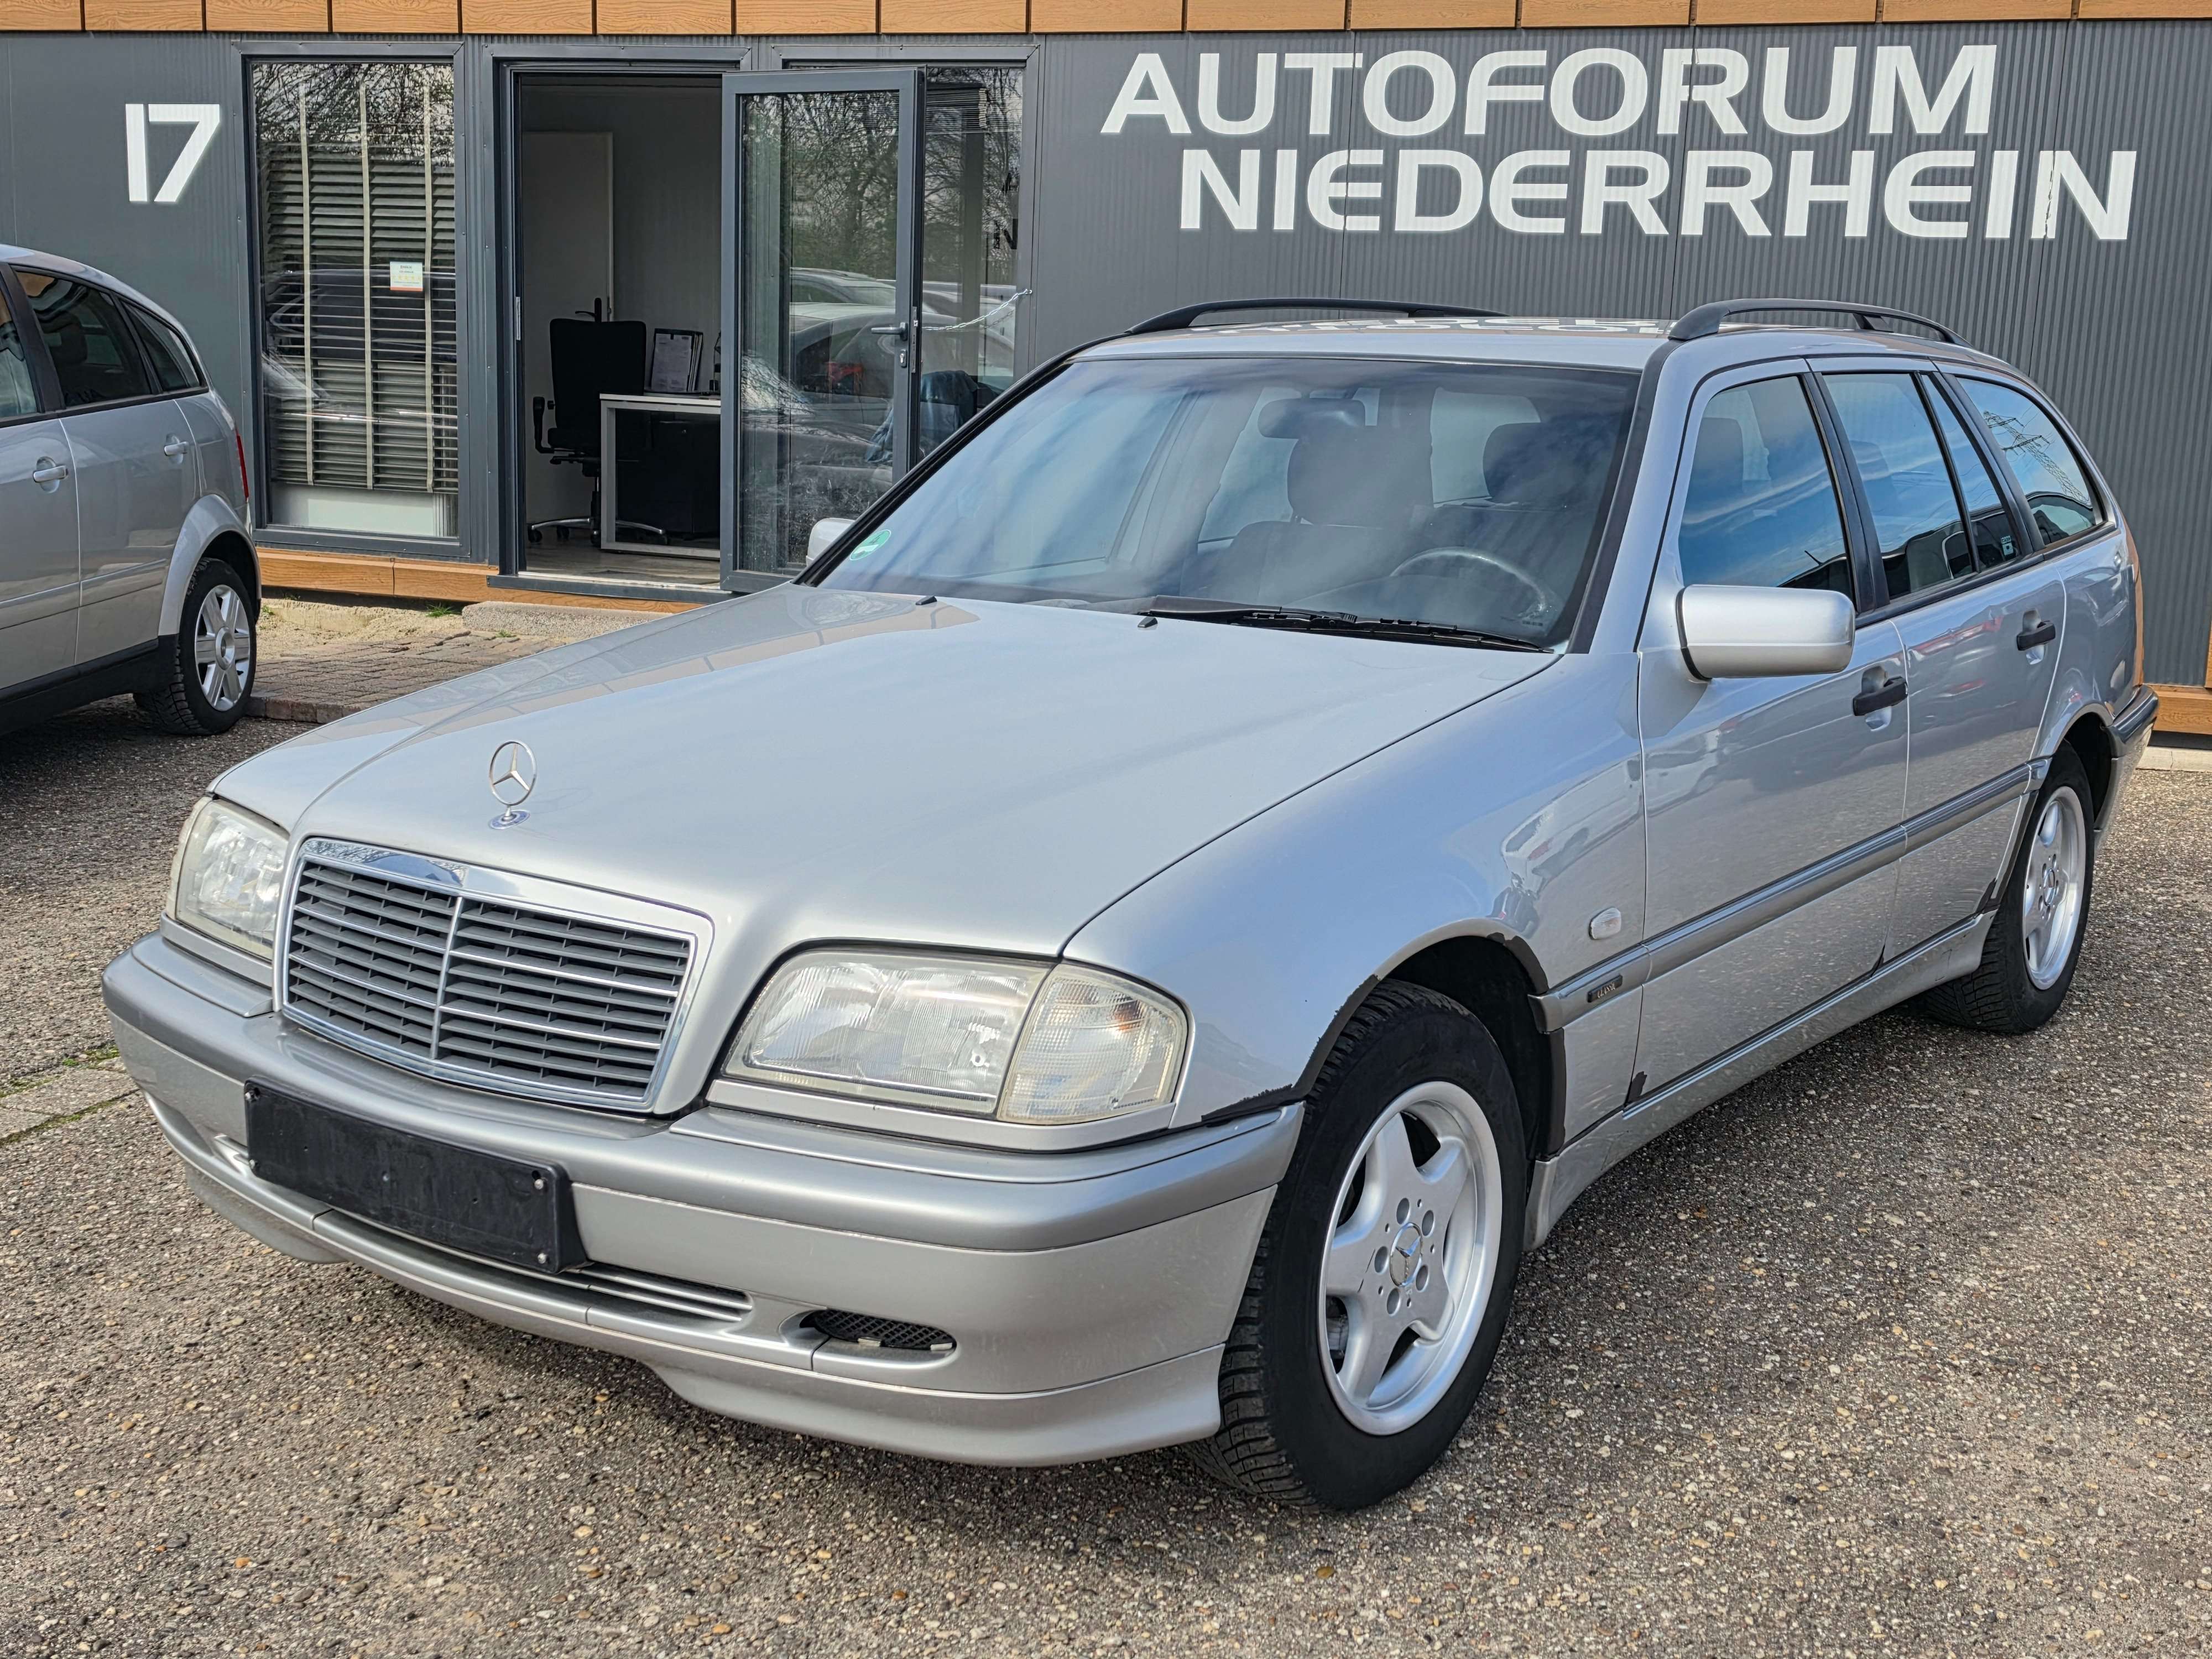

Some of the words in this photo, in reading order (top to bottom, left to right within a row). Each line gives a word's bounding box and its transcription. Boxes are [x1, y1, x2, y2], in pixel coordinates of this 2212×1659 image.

[1100, 44, 1997, 137] AUTOFORUM
[125, 103, 221, 203] 17
[1180, 149, 2138, 241] NIEDERRHEIN
